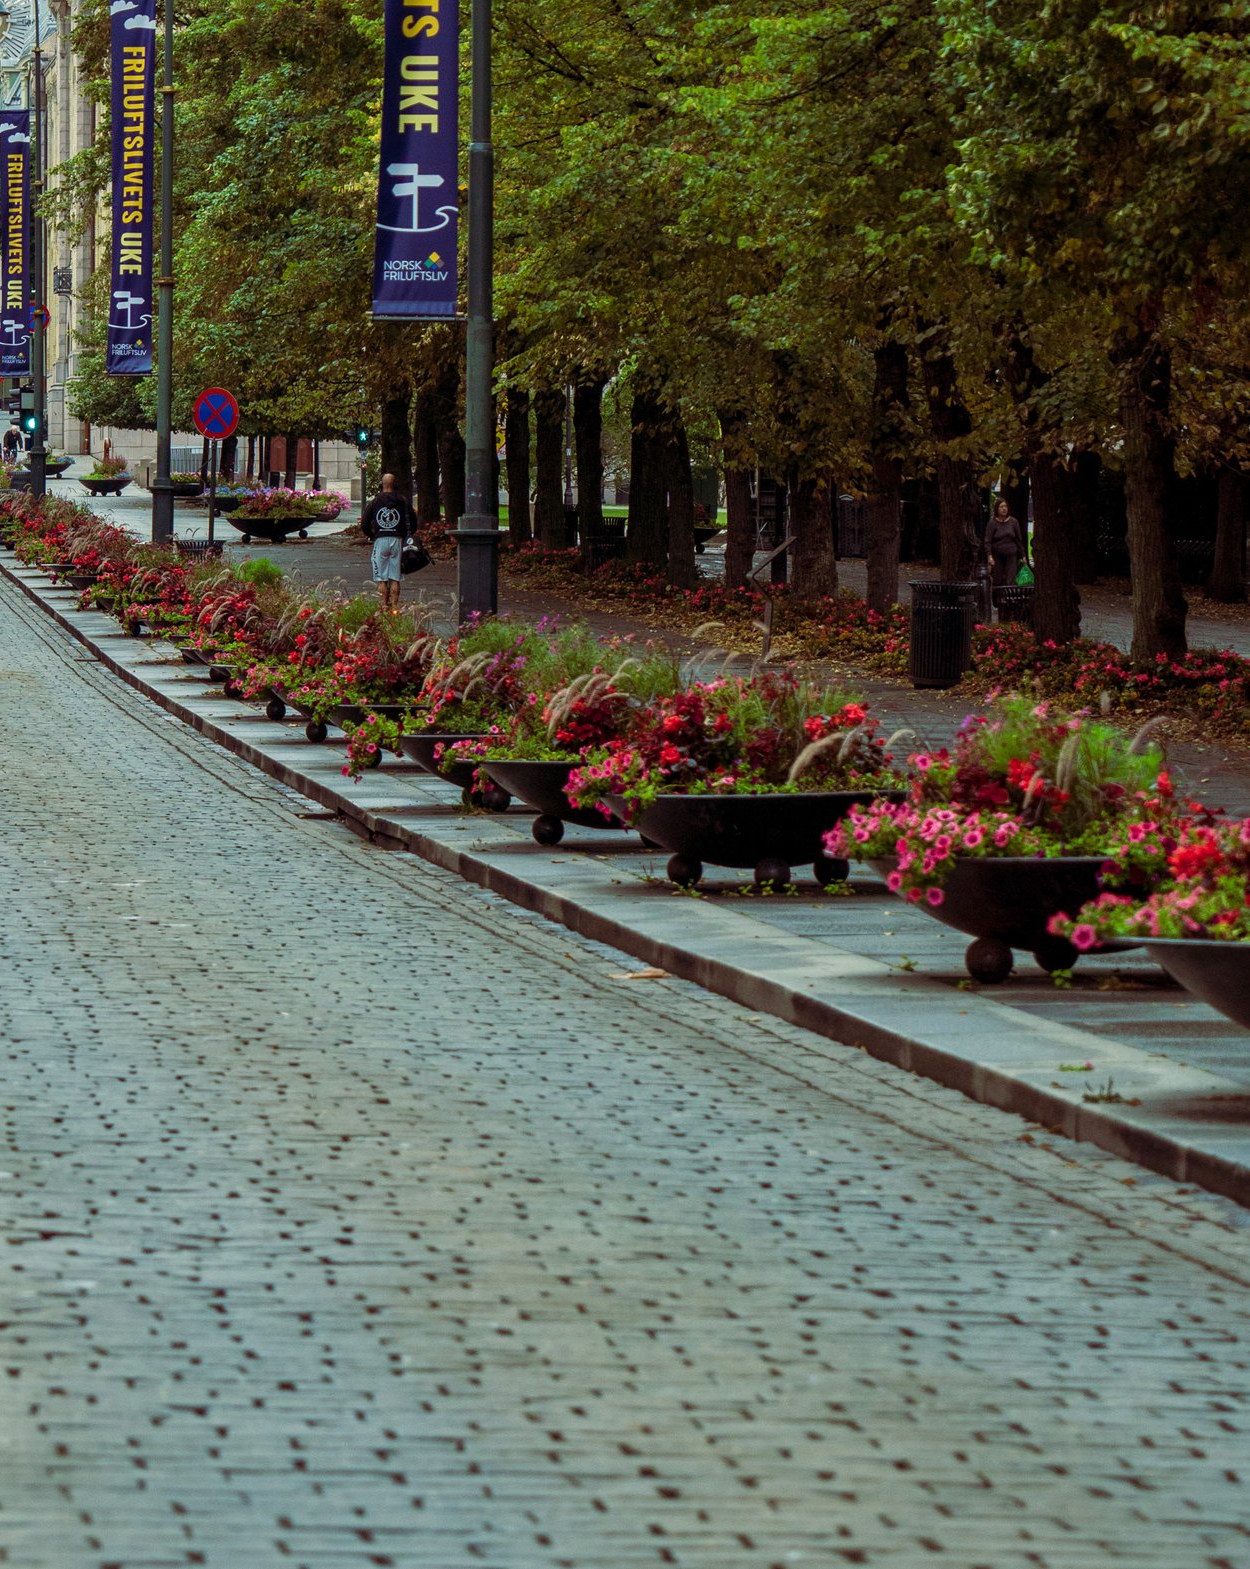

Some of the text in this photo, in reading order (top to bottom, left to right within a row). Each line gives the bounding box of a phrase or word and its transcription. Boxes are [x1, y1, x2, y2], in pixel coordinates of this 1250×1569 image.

[398, 56, 439, 134] UKE
[119, 46, 146, 276] FRILUFTSLIVETS UKE
[6, 154, 23, 310] FRILUFTSLIVETS UKE
[383, 260, 422, 270] NORSK
[383, 271, 449, 281] FRILUFTSLIV
